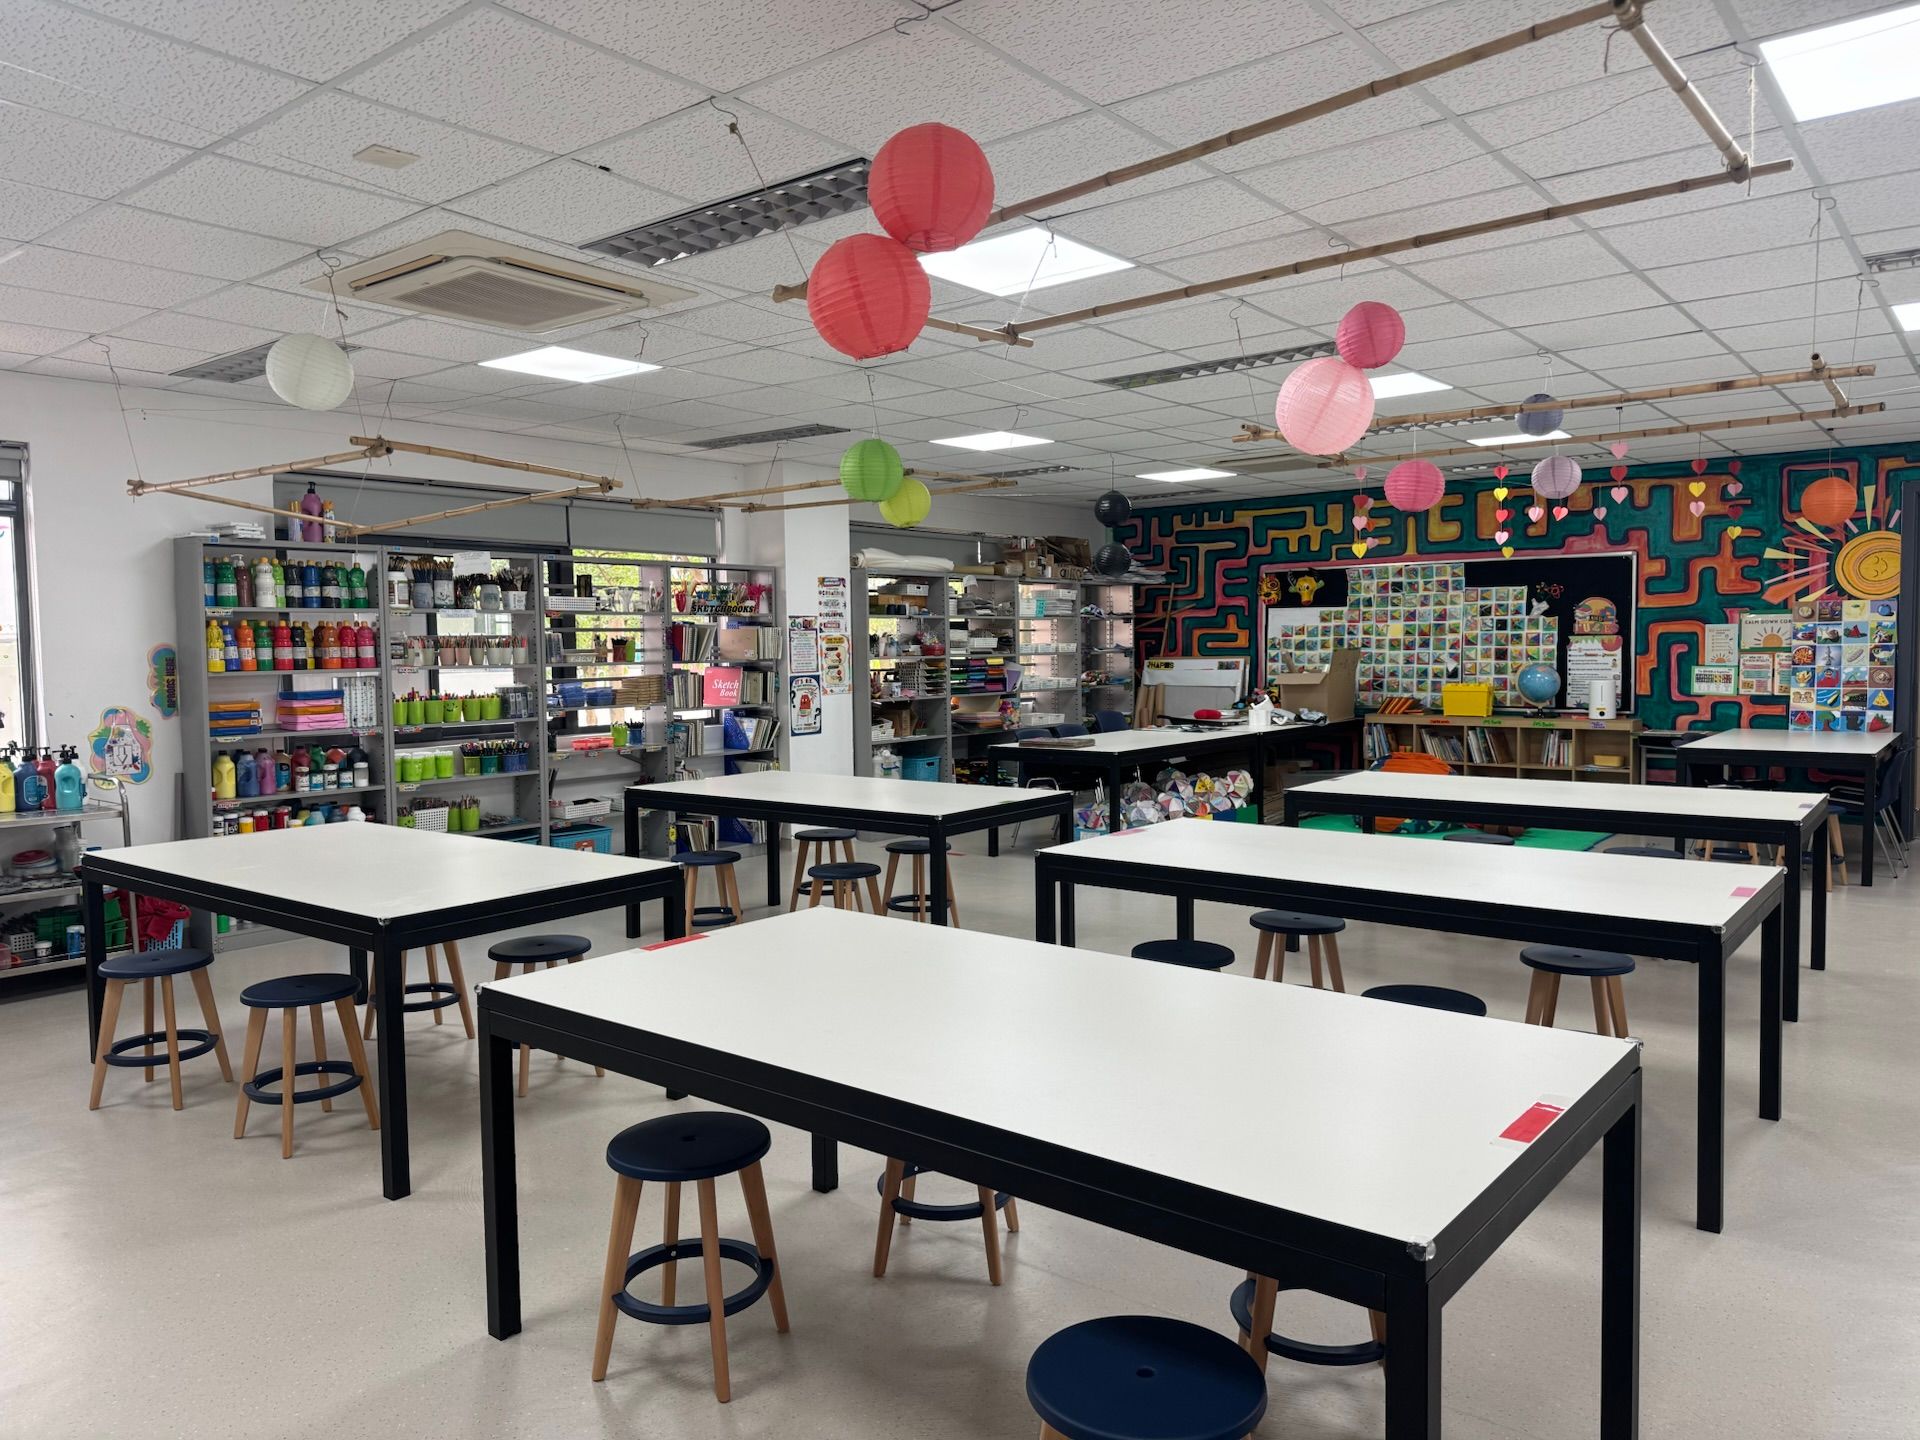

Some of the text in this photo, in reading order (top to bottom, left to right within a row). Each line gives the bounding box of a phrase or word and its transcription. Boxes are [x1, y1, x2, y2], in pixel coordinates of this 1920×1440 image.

[691, 604, 755, 613] SKETCHBOOKS
[712, 679, 739, 689] Sketch
[720, 688, 737, 697] Book
